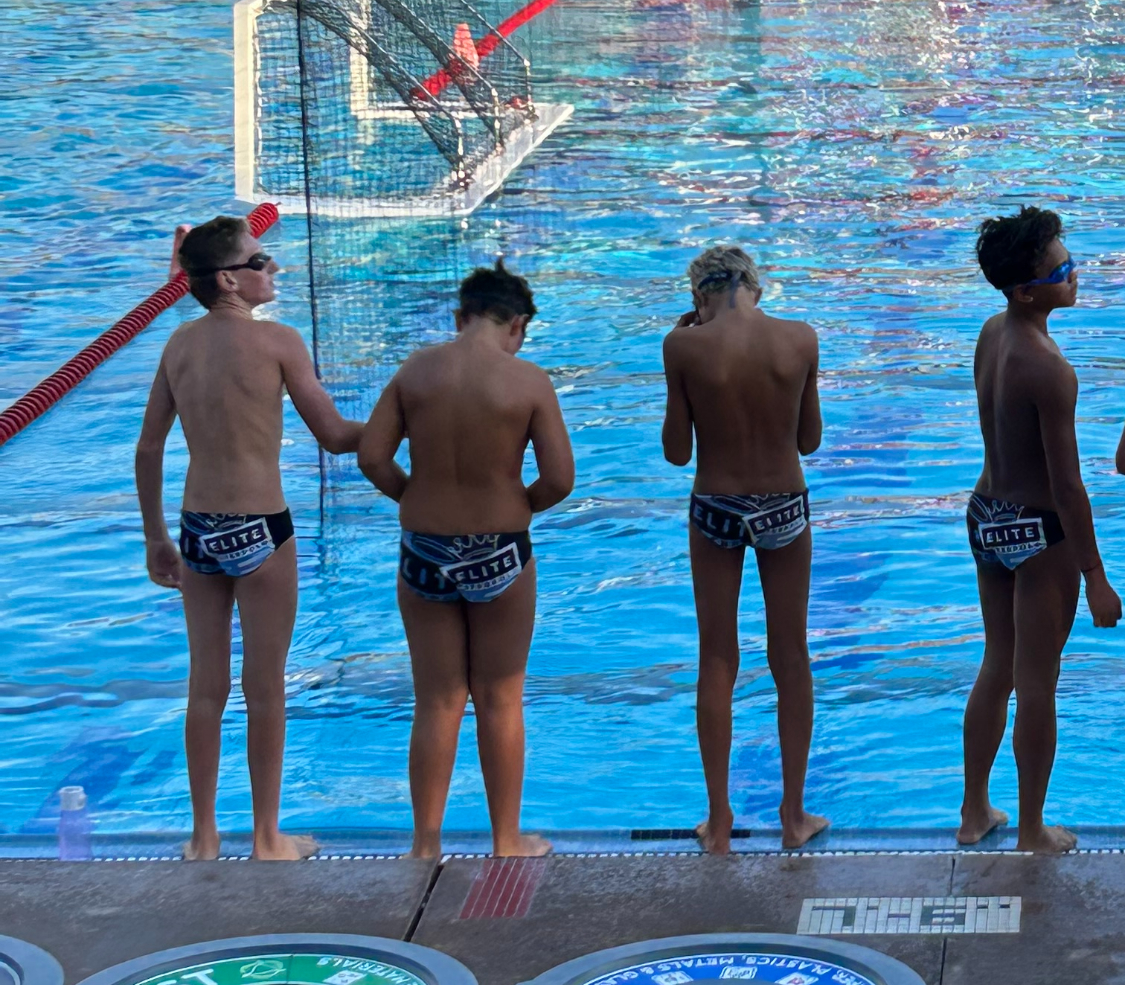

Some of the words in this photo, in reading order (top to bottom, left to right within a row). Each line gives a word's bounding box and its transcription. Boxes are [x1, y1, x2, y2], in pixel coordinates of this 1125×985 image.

[209, 528, 262, 552] ELITE
[986, 526, 1035, 543] ELITE
[455, 555, 513, 582] ELITE
[316, 956, 411, 984] MATERIALS
[657, 956, 734, 971] METALS
